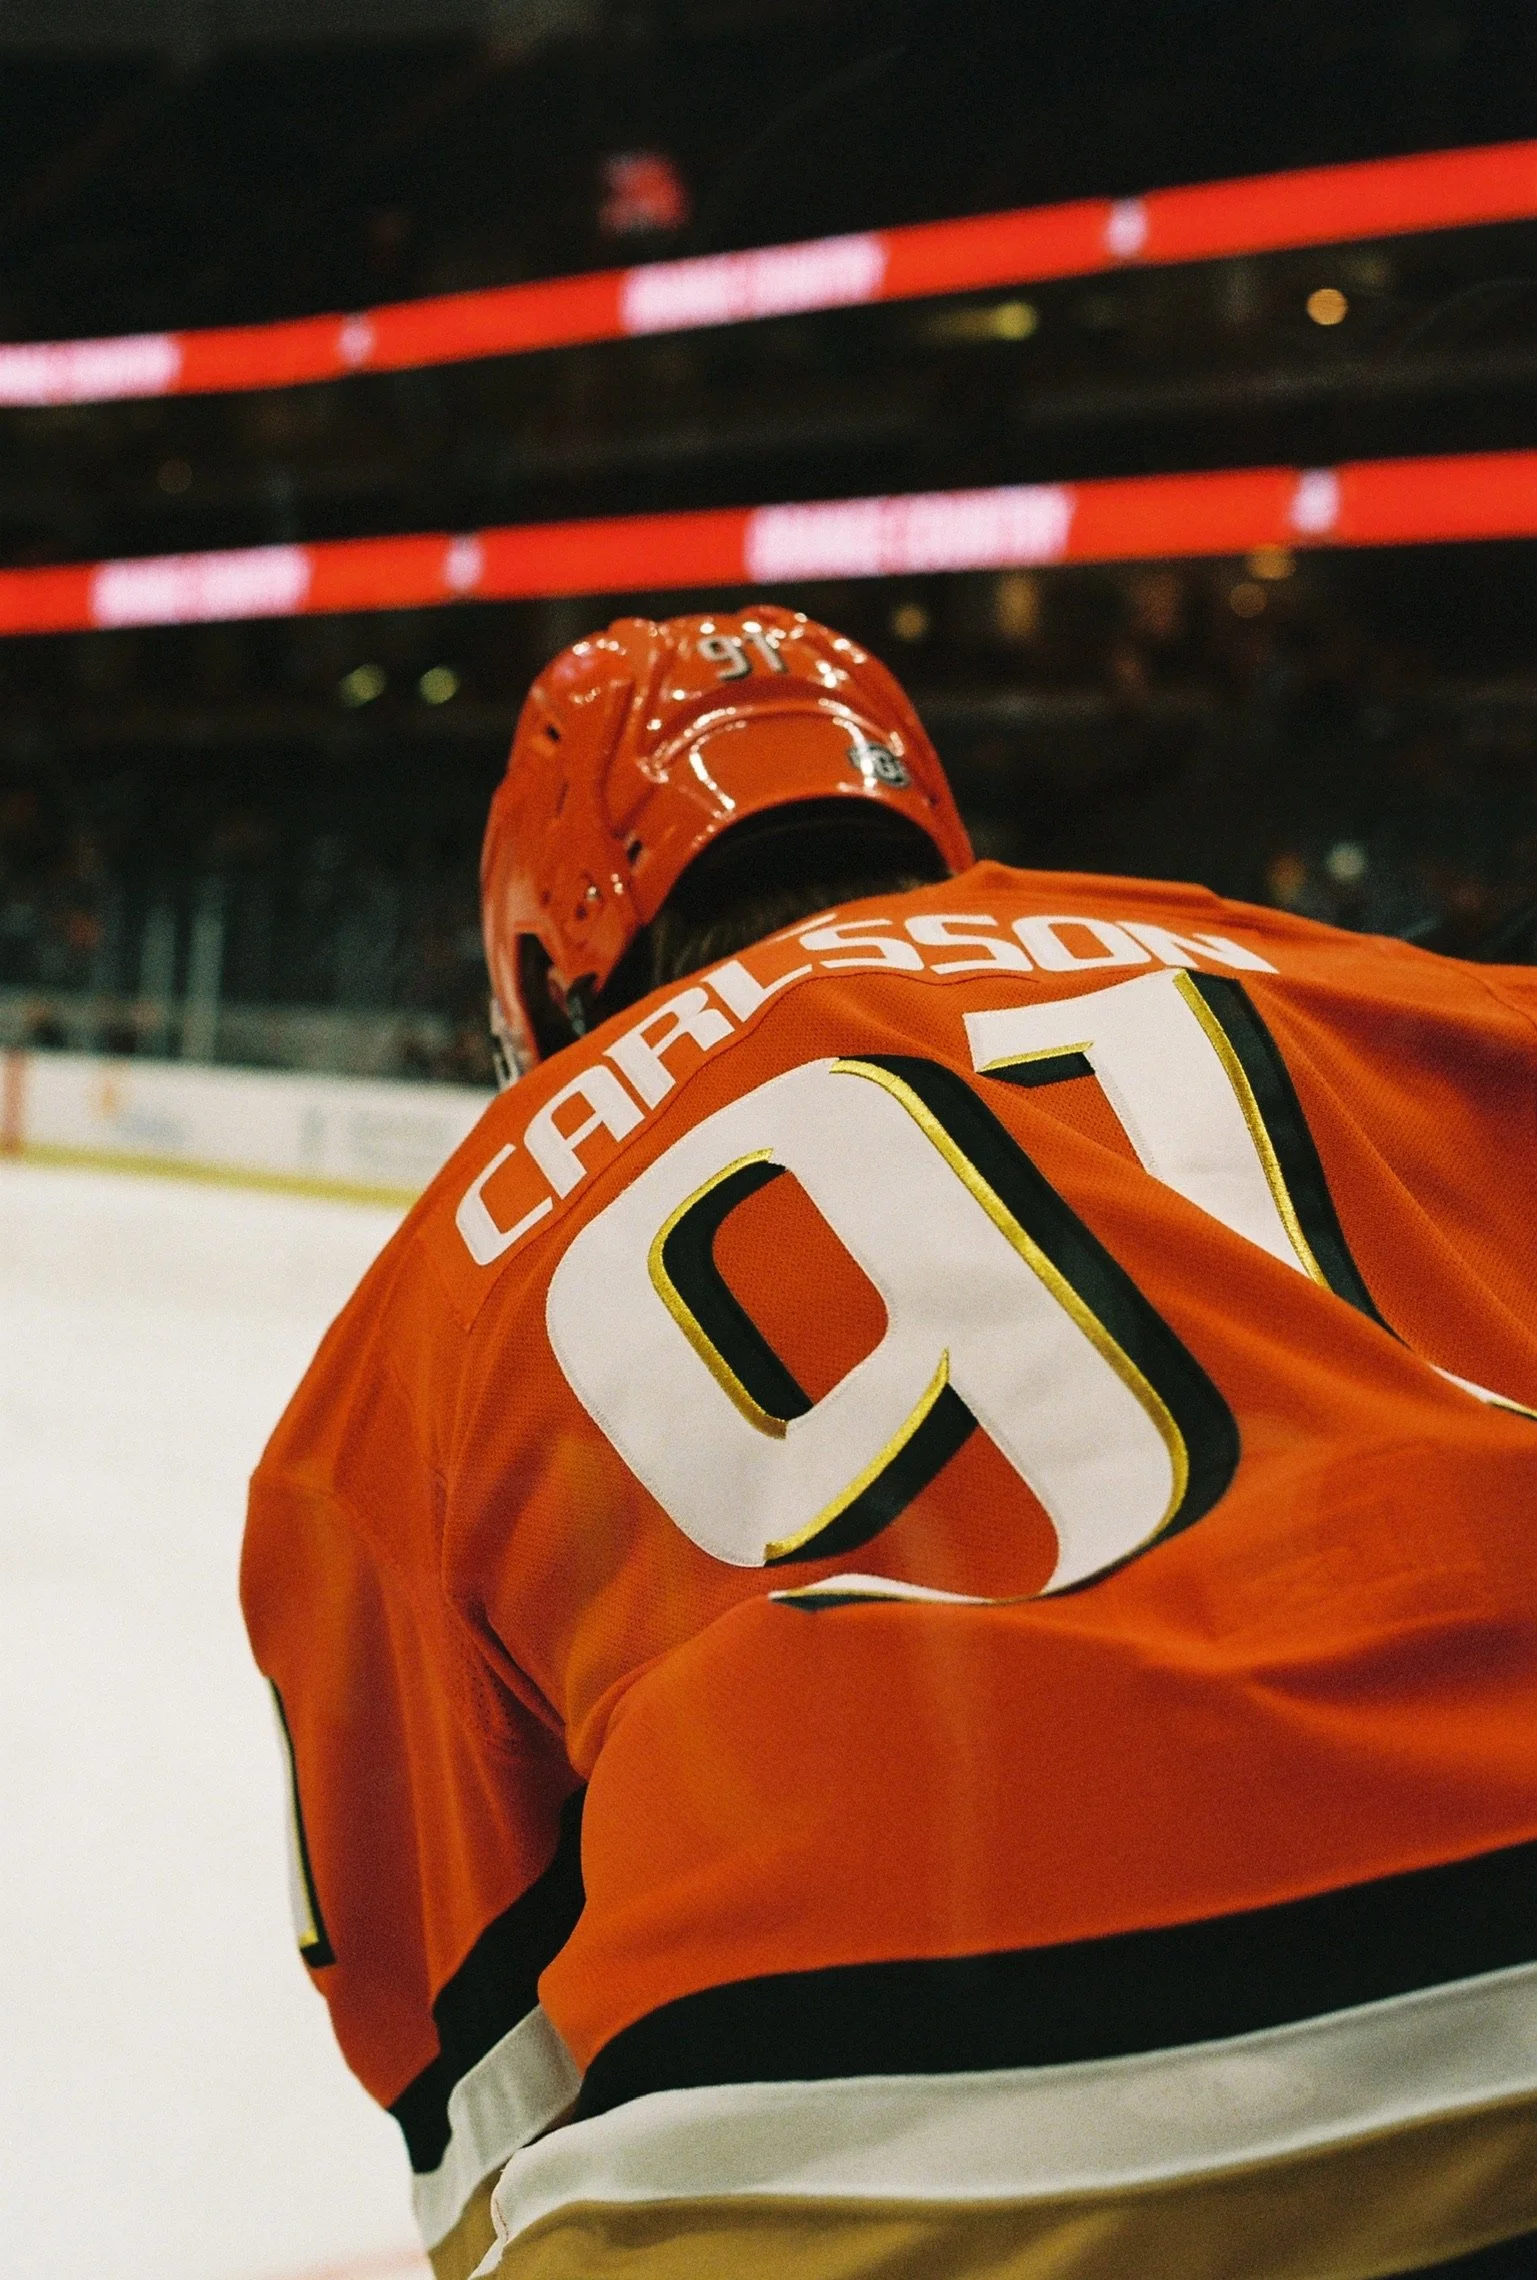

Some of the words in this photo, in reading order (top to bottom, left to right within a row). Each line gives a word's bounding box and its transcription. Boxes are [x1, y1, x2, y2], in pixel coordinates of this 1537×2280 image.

[697, 622, 789, 681] 91
[455, 913, 1281, 1267] CARLSSON
[545, 966, 1537, 1613] 91
